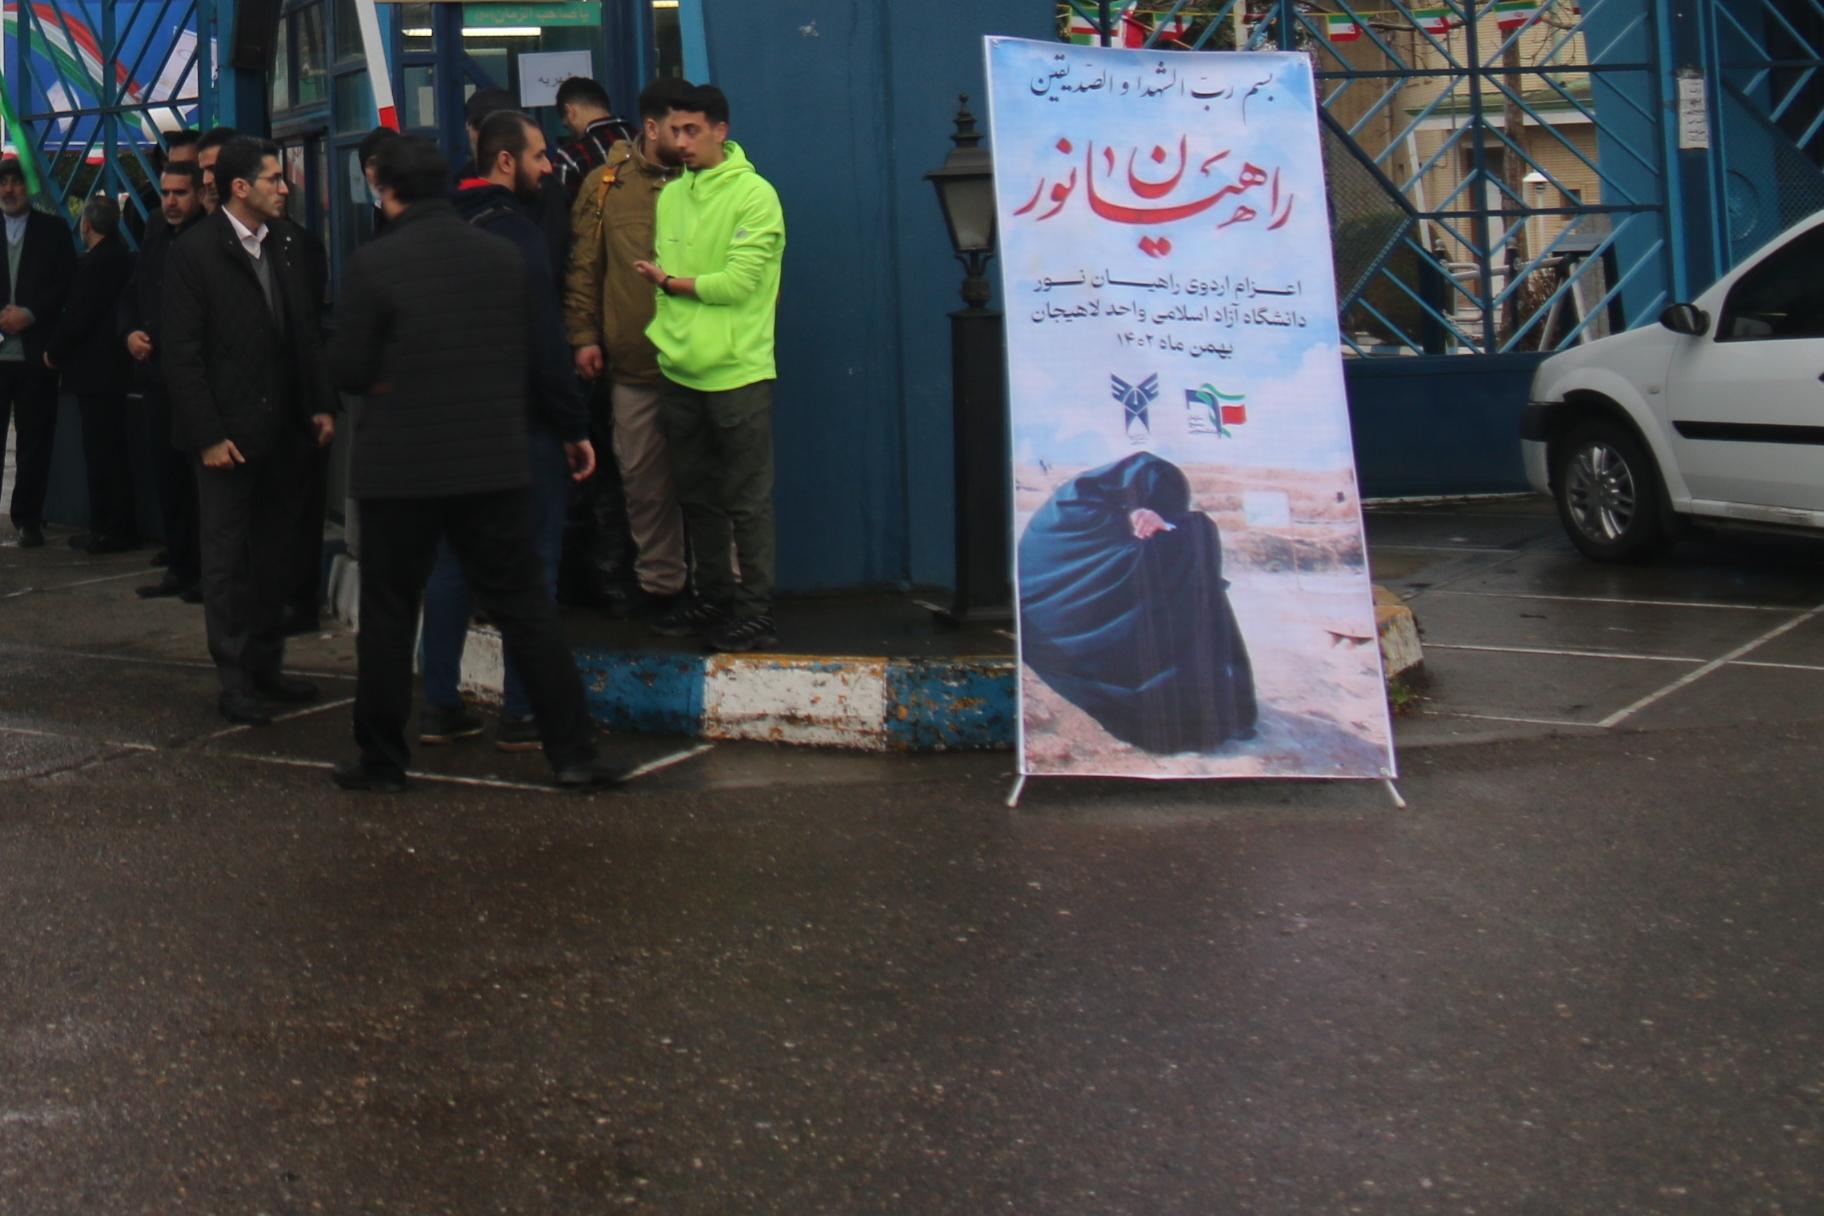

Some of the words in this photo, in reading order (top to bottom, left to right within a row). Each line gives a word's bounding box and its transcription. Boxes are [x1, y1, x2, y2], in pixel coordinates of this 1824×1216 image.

[1242, 72, 1274, 126] بسم
[1012, 137, 1078, 221] نور
[1186, 276, 1231, 297] اردوی
[1031, 298, 1100, 324] لاهیجان
[1106, 300, 1147, 323] واحد
[1152, 304, 1209, 326] اسلامی
[1213, 303, 1239, 328] آزاد
[1243, 306, 1308, 329] دانشگاه
[1115, 331, 1154, 348] ۱۴۰۲
[1159, 333, 1185, 352] ماه
[1189, 341, 1234, 360] بهمن
